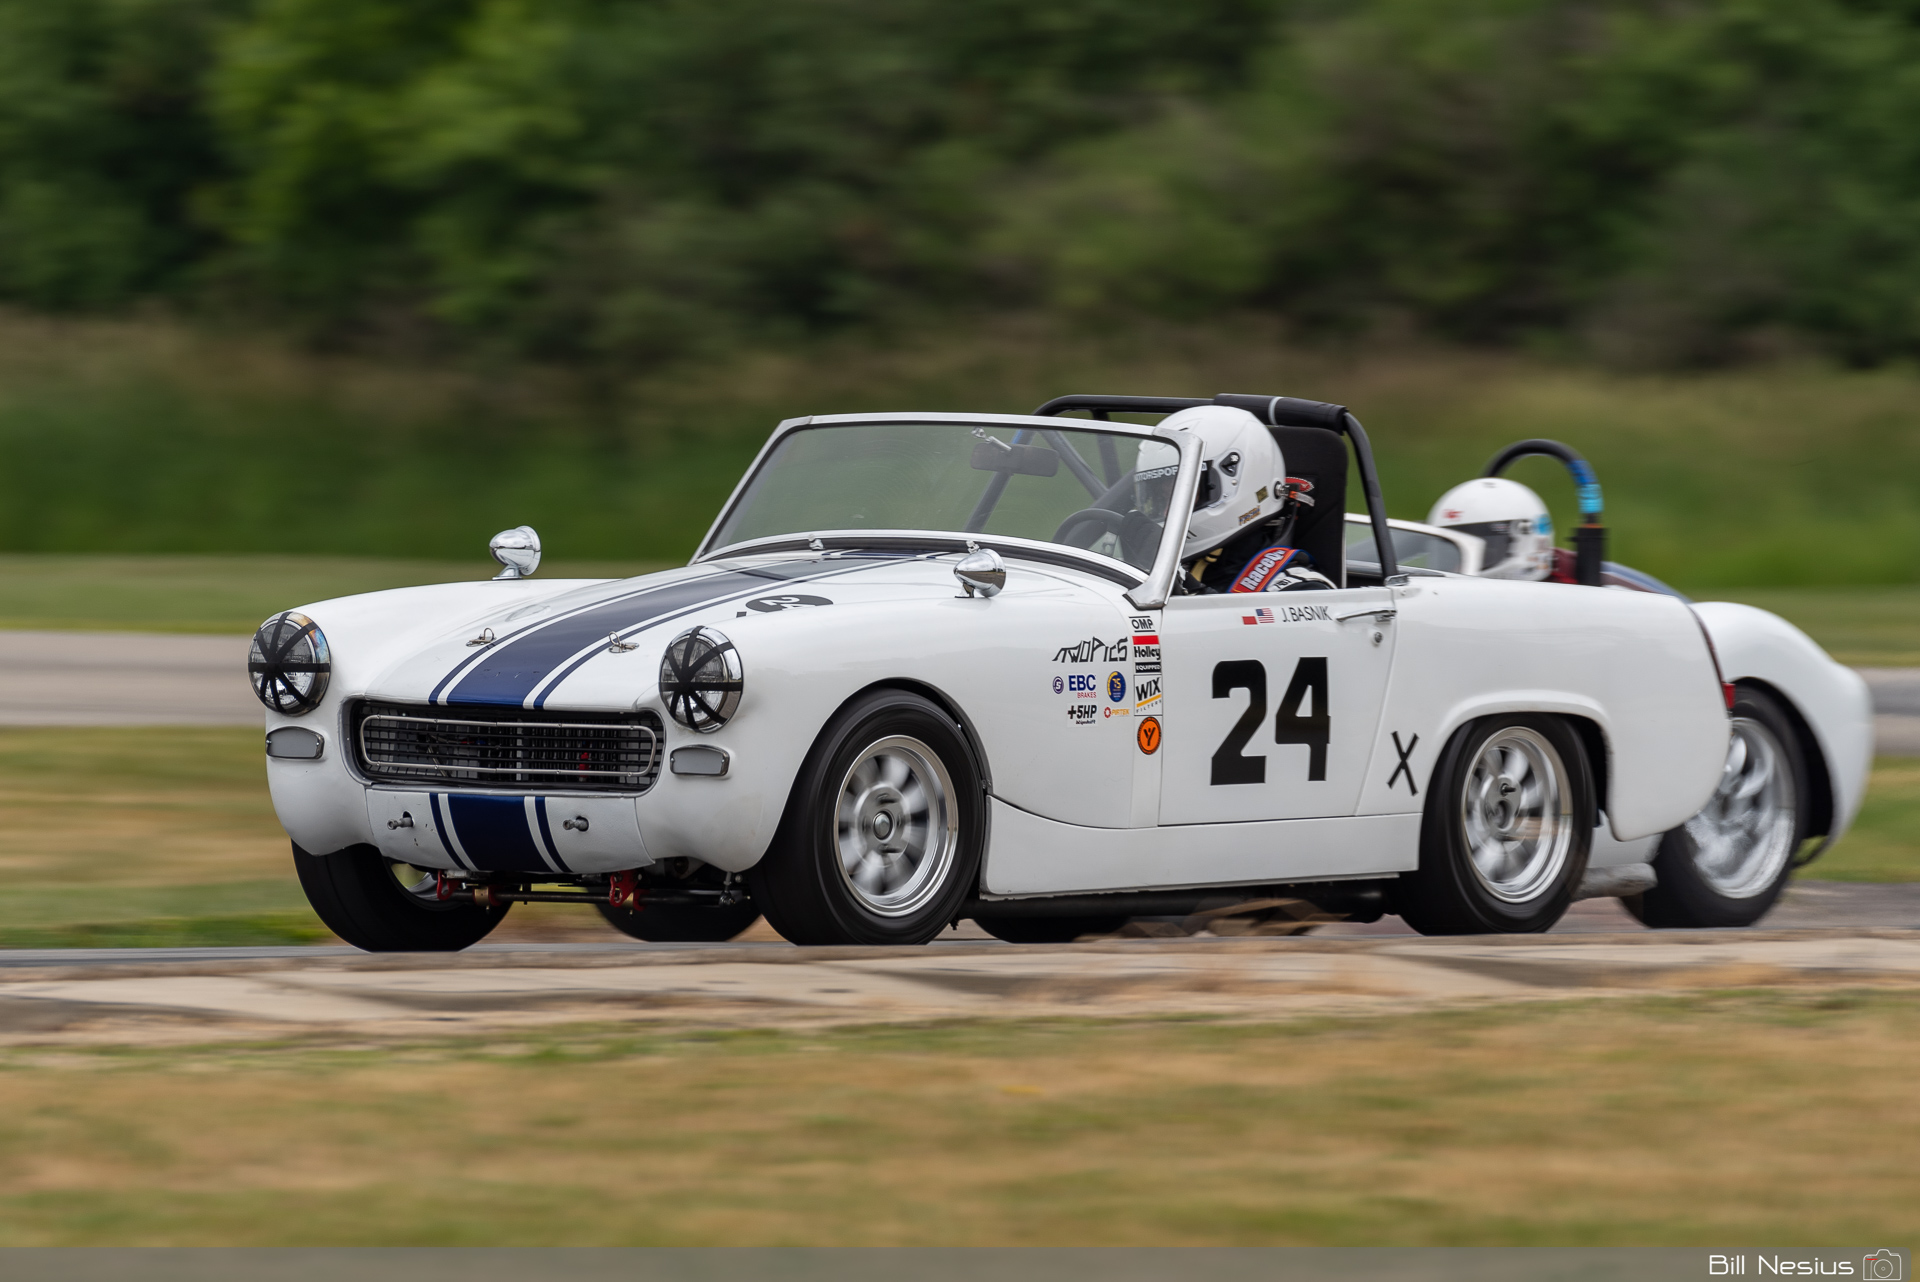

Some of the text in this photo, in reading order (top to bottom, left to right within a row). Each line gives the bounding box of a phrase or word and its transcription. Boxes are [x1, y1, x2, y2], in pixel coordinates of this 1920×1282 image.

[1131, 618, 1154, 630] OMP
[1133, 645, 1161, 661] Holley
[1068, 675, 1097, 691] EBC
[1136, 677, 1162, 702] WIX
[1067, 704, 1098, 720] +5HP
[1136, 699, 1162, 714] FILTERS
[1210, 657, 1331, 786] 24
[1386, 731, 1419, 797] X
